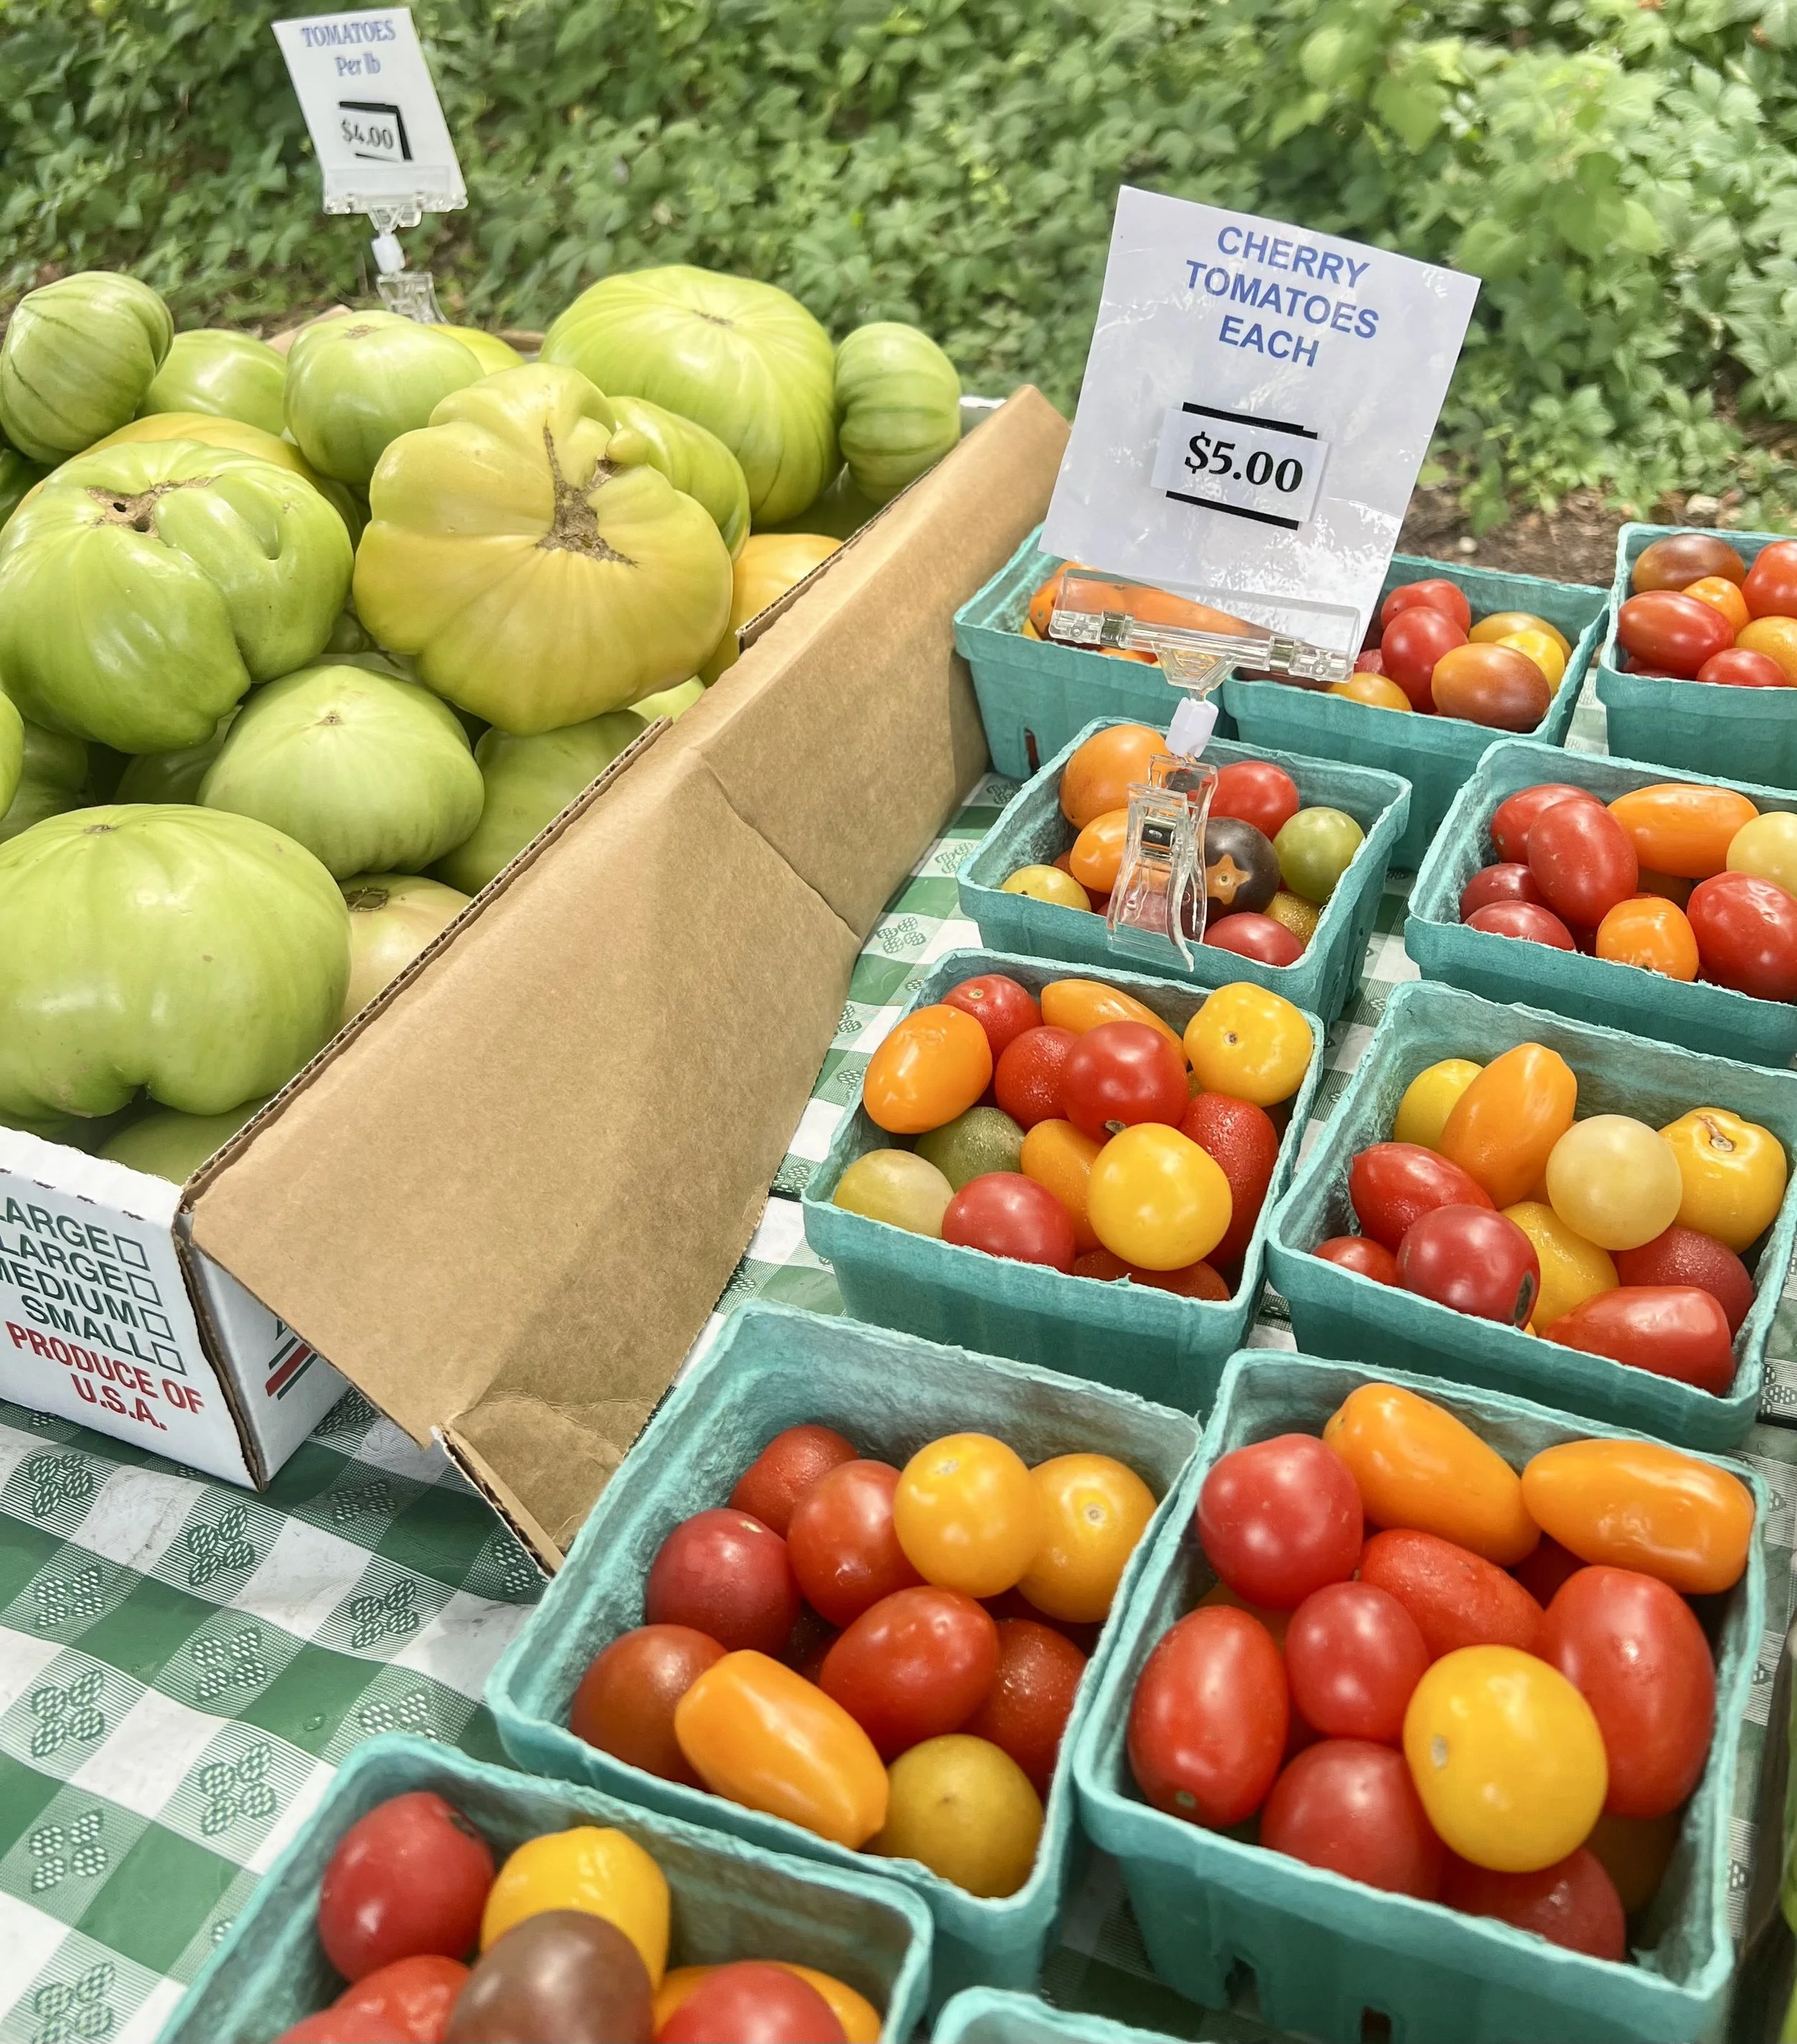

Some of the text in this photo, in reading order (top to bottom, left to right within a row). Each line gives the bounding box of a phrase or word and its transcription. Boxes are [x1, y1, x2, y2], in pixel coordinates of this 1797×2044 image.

[300, 19, 396, 47] TOMATOES
[334, 52, 382, 76] Per lb
[341, 117, 394, 149] $4.00
[1217, 226, 1370, 288] CHERRY
[1186, 259, 1379, 339] TOMATOES
[1219, 315, 1320, 367] EACH
[1185, 431, 1303, 494] $5.00
[0, 1196, 117, 1259] ARGE
[22, 1294, 157, 1364] SMALL
[5, 1321, 205, 1414] PRODUCE OF
[70, 1373, 168, 1431] U.S.A.
